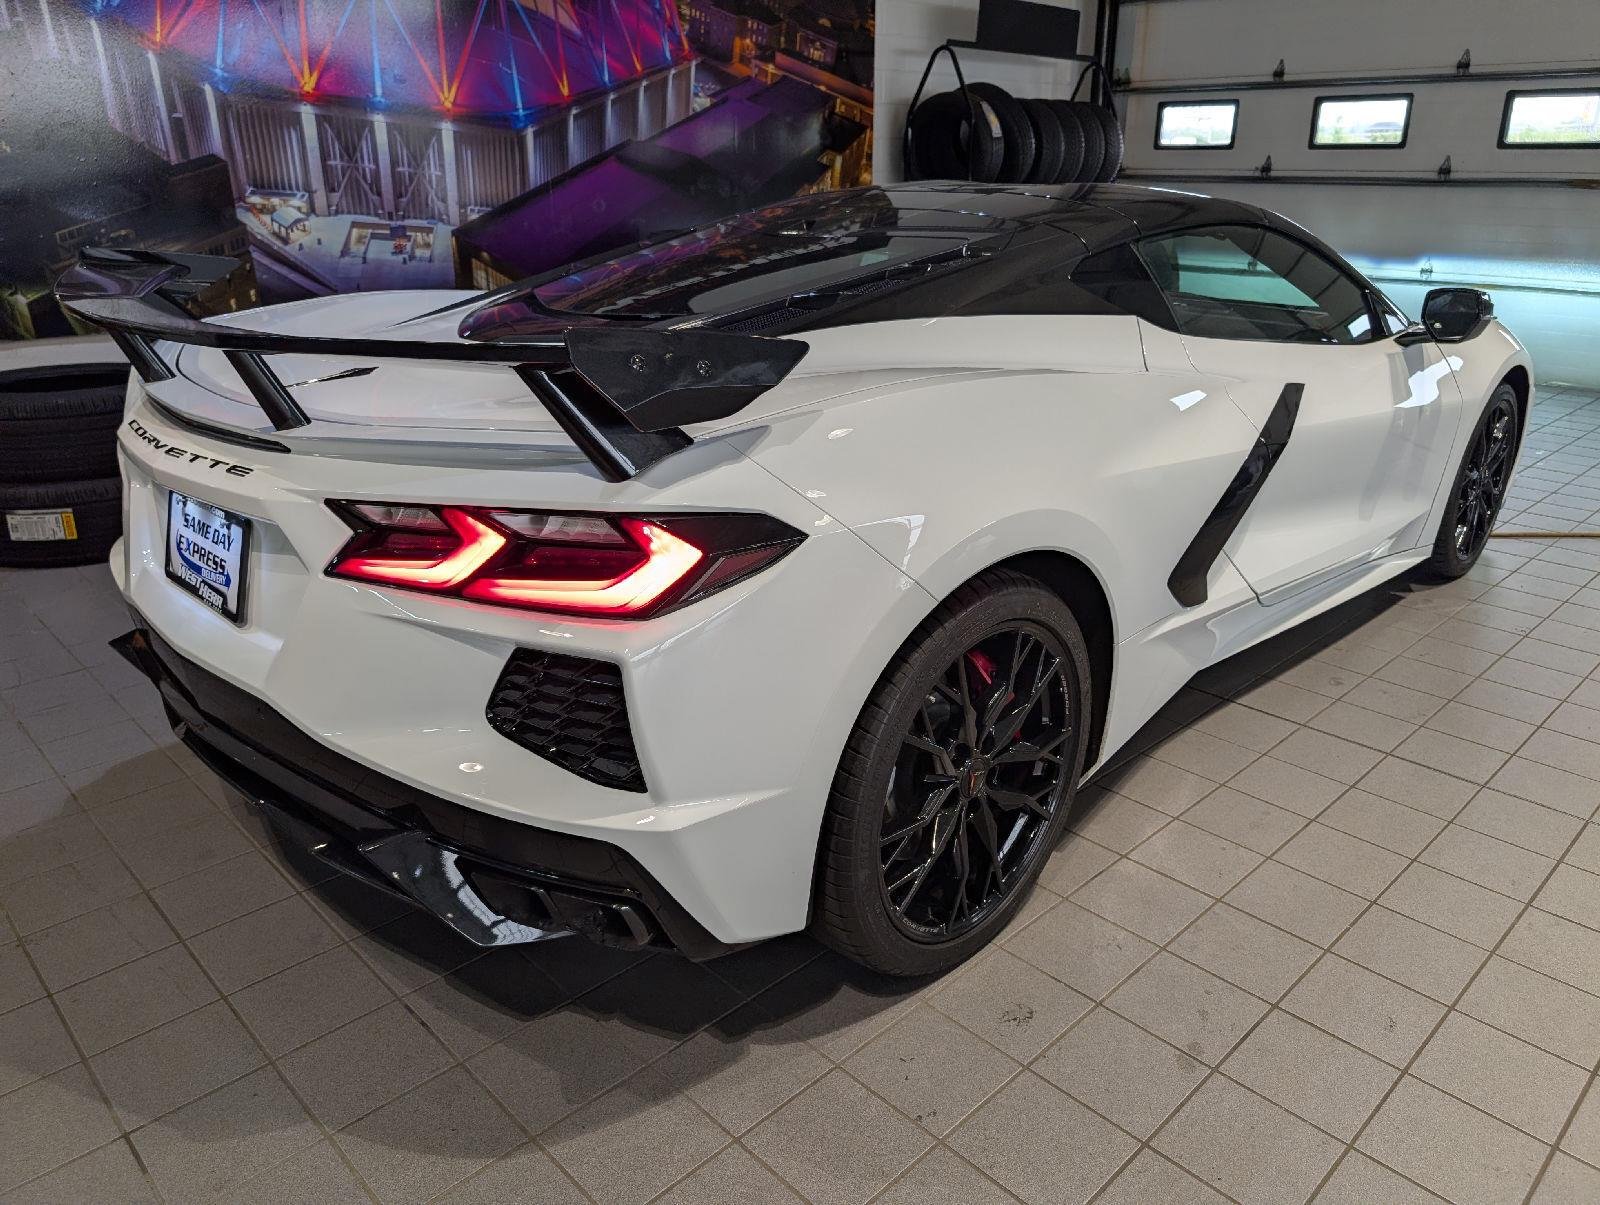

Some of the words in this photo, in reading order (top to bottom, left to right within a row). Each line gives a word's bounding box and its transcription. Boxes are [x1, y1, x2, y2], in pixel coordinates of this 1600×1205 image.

[128, 419, 254, 478] CORVETTE
[183, 514, 212, 540] SAME
[211, 528, 235, 552] DAY
[178, 534, 228, 575] EXPRESS
[201, 567, 227, 587] DELIVERY
